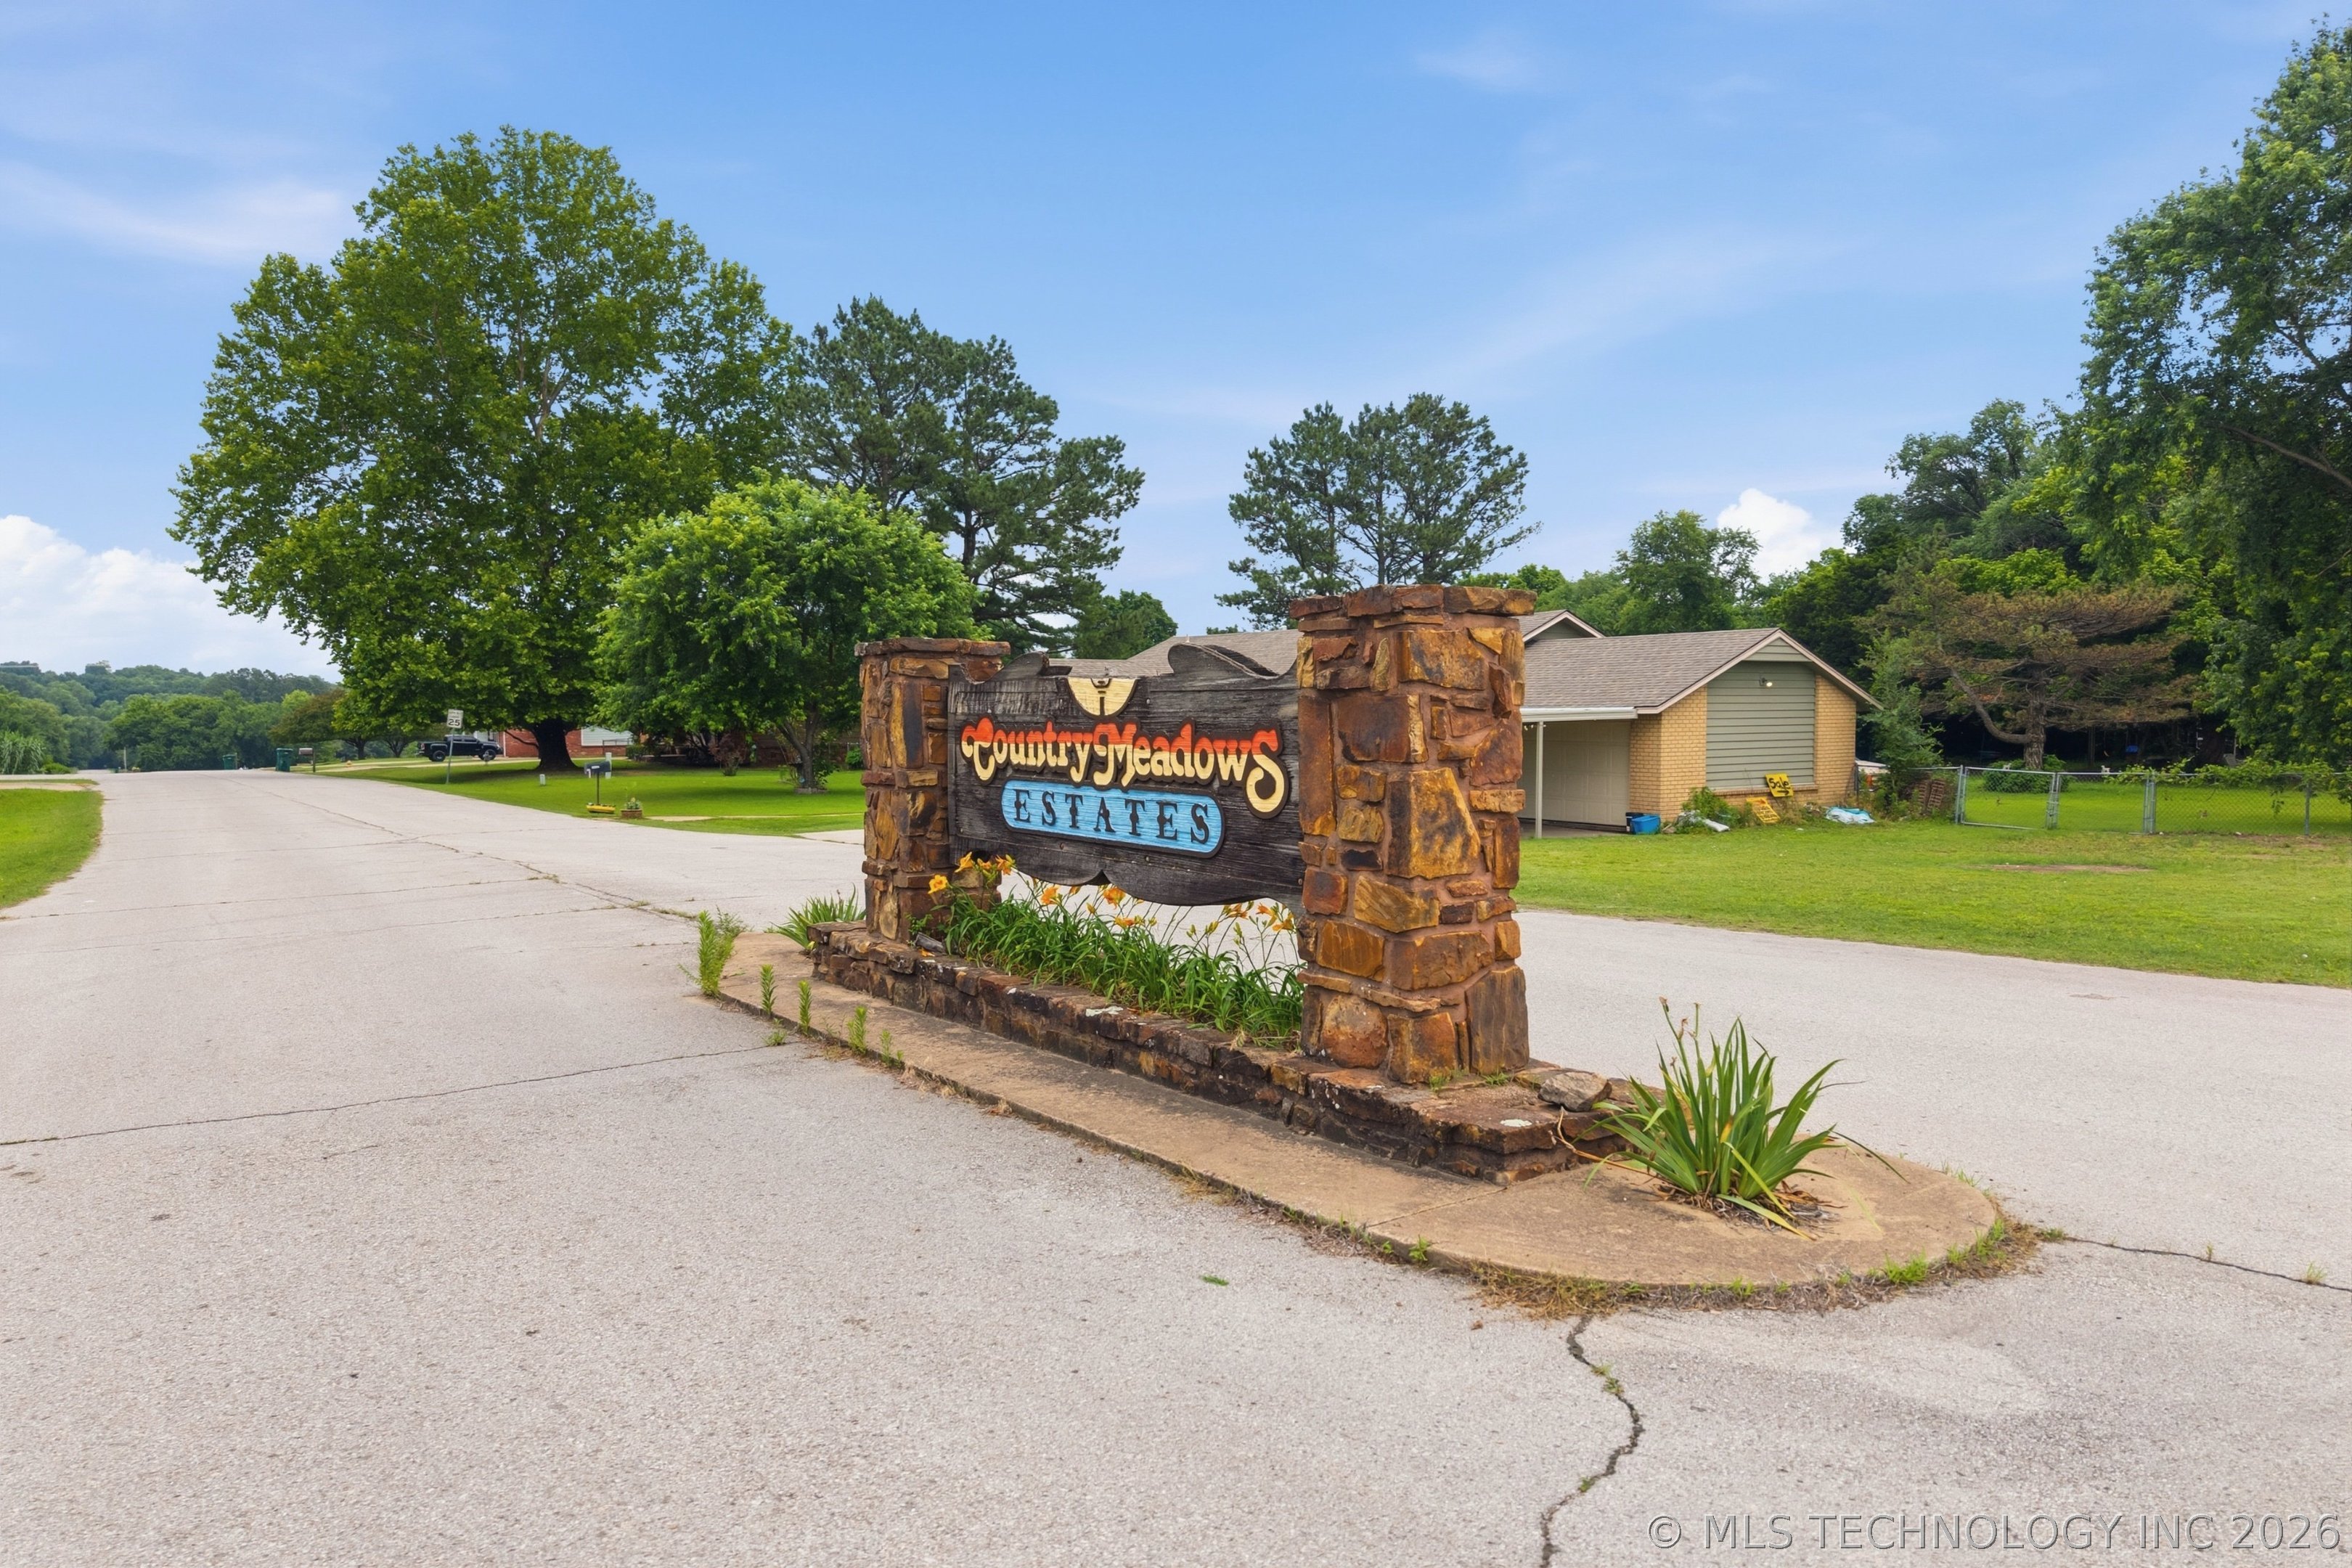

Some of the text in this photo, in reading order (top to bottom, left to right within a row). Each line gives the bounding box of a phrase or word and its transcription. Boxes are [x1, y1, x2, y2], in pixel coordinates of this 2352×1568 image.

[960, 716, 1094, 783] Country
[1768, 777, 1791, 790] Sale
[1013, 788, 1210, 844] ESTATES
